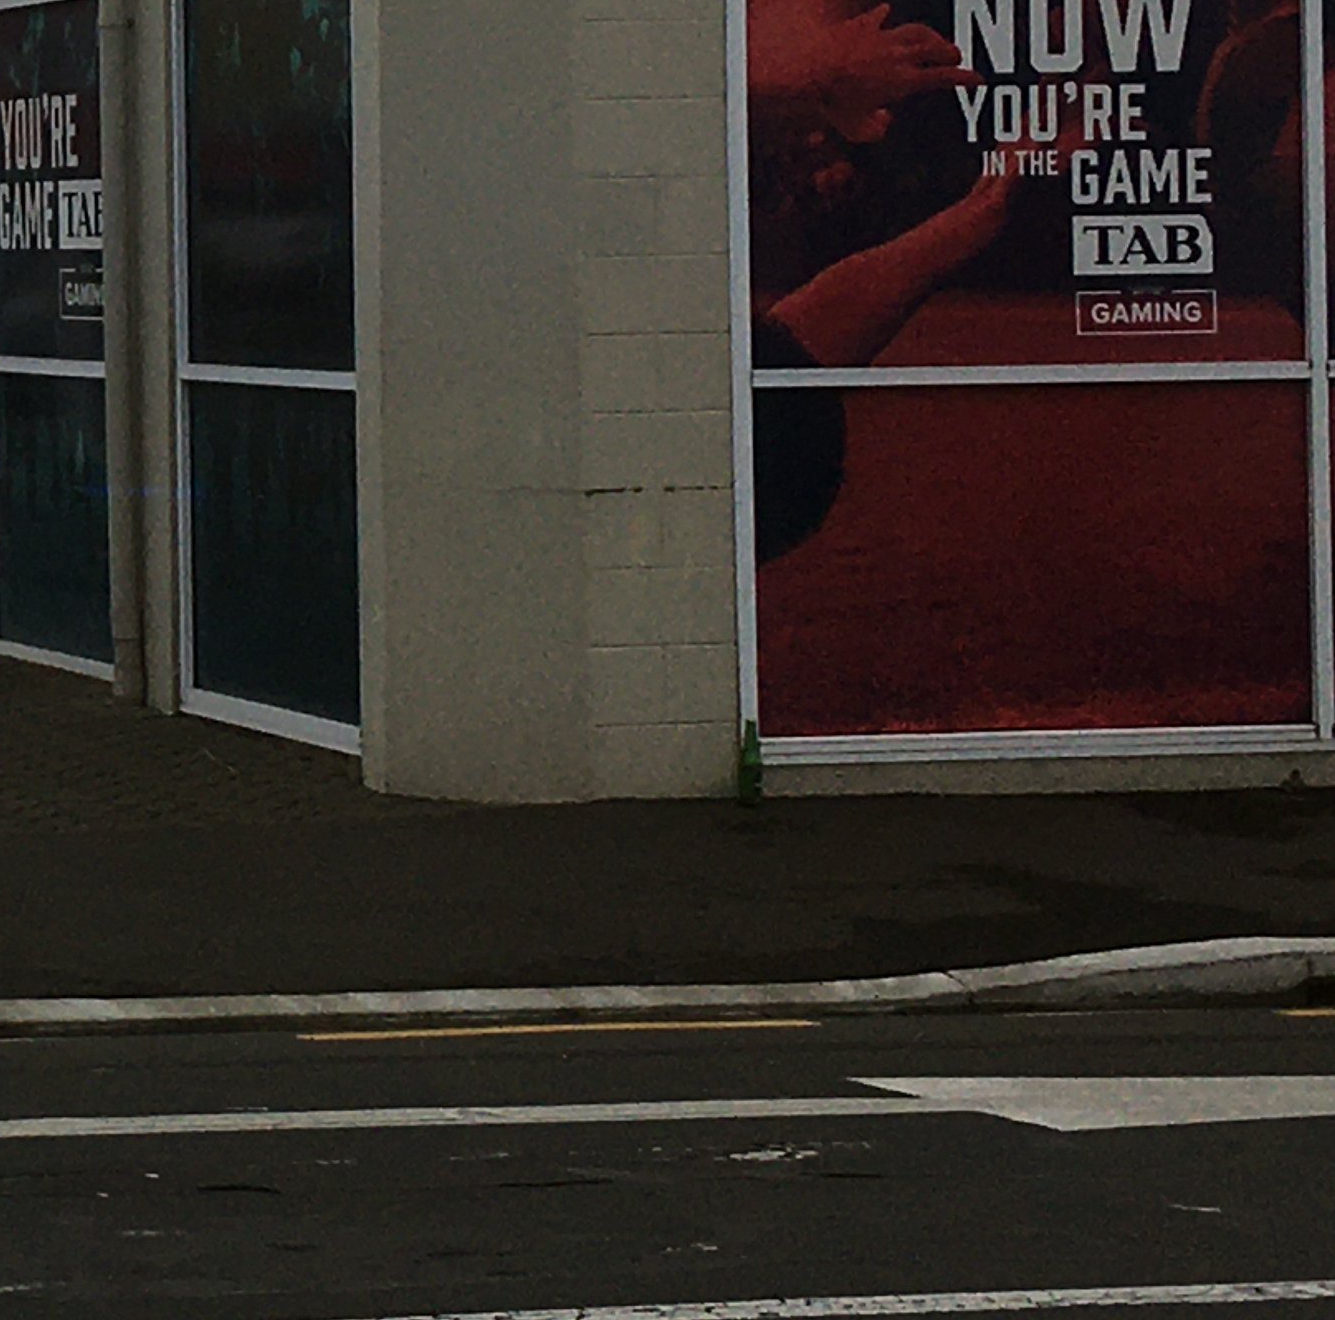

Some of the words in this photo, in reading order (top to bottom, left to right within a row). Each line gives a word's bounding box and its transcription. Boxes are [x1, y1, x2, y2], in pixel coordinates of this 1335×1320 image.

[0, 92, 79, 170] YOU'RE
[954, 80, 1148, 143] YOU'RE
[982, 150, 1007, 177] IN
[1017, 149, 1059, 177] THE
[1070, 147, 1213, 205] GAME
[1082, 224, 1203, 266] TAB
[1090, 301, 1203, 325] GAMING
